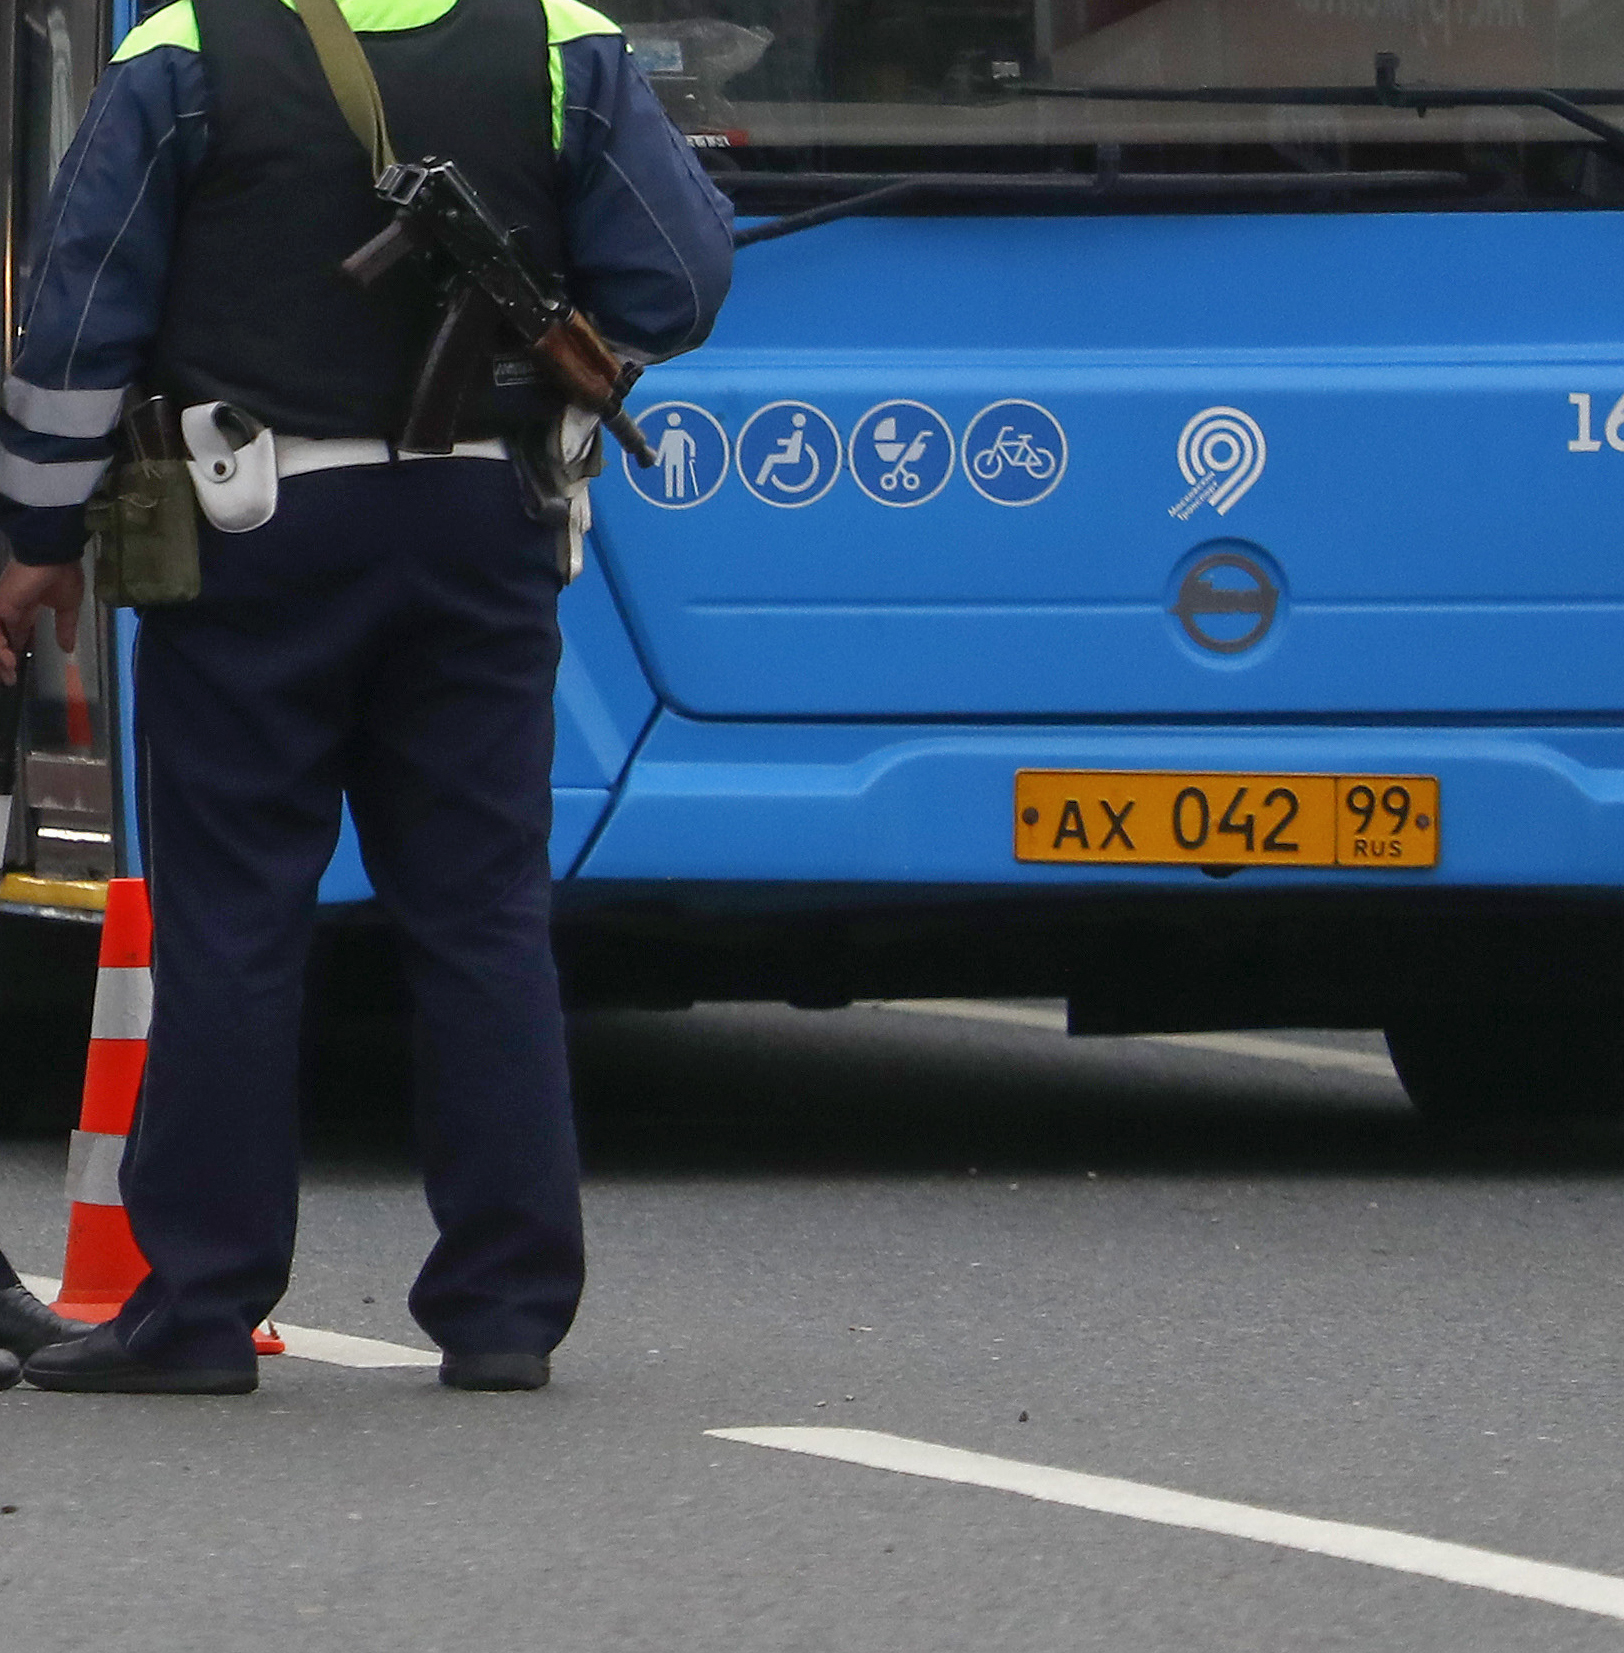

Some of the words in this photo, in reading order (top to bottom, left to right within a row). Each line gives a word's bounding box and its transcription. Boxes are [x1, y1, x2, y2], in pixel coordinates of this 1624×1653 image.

[1051, 795, 1136, 853] АХ
[1171, 786, 1300, 853] 042
[1344, 783, 1411, 835] 99
[1353, 836, 1404, 859] RUS
